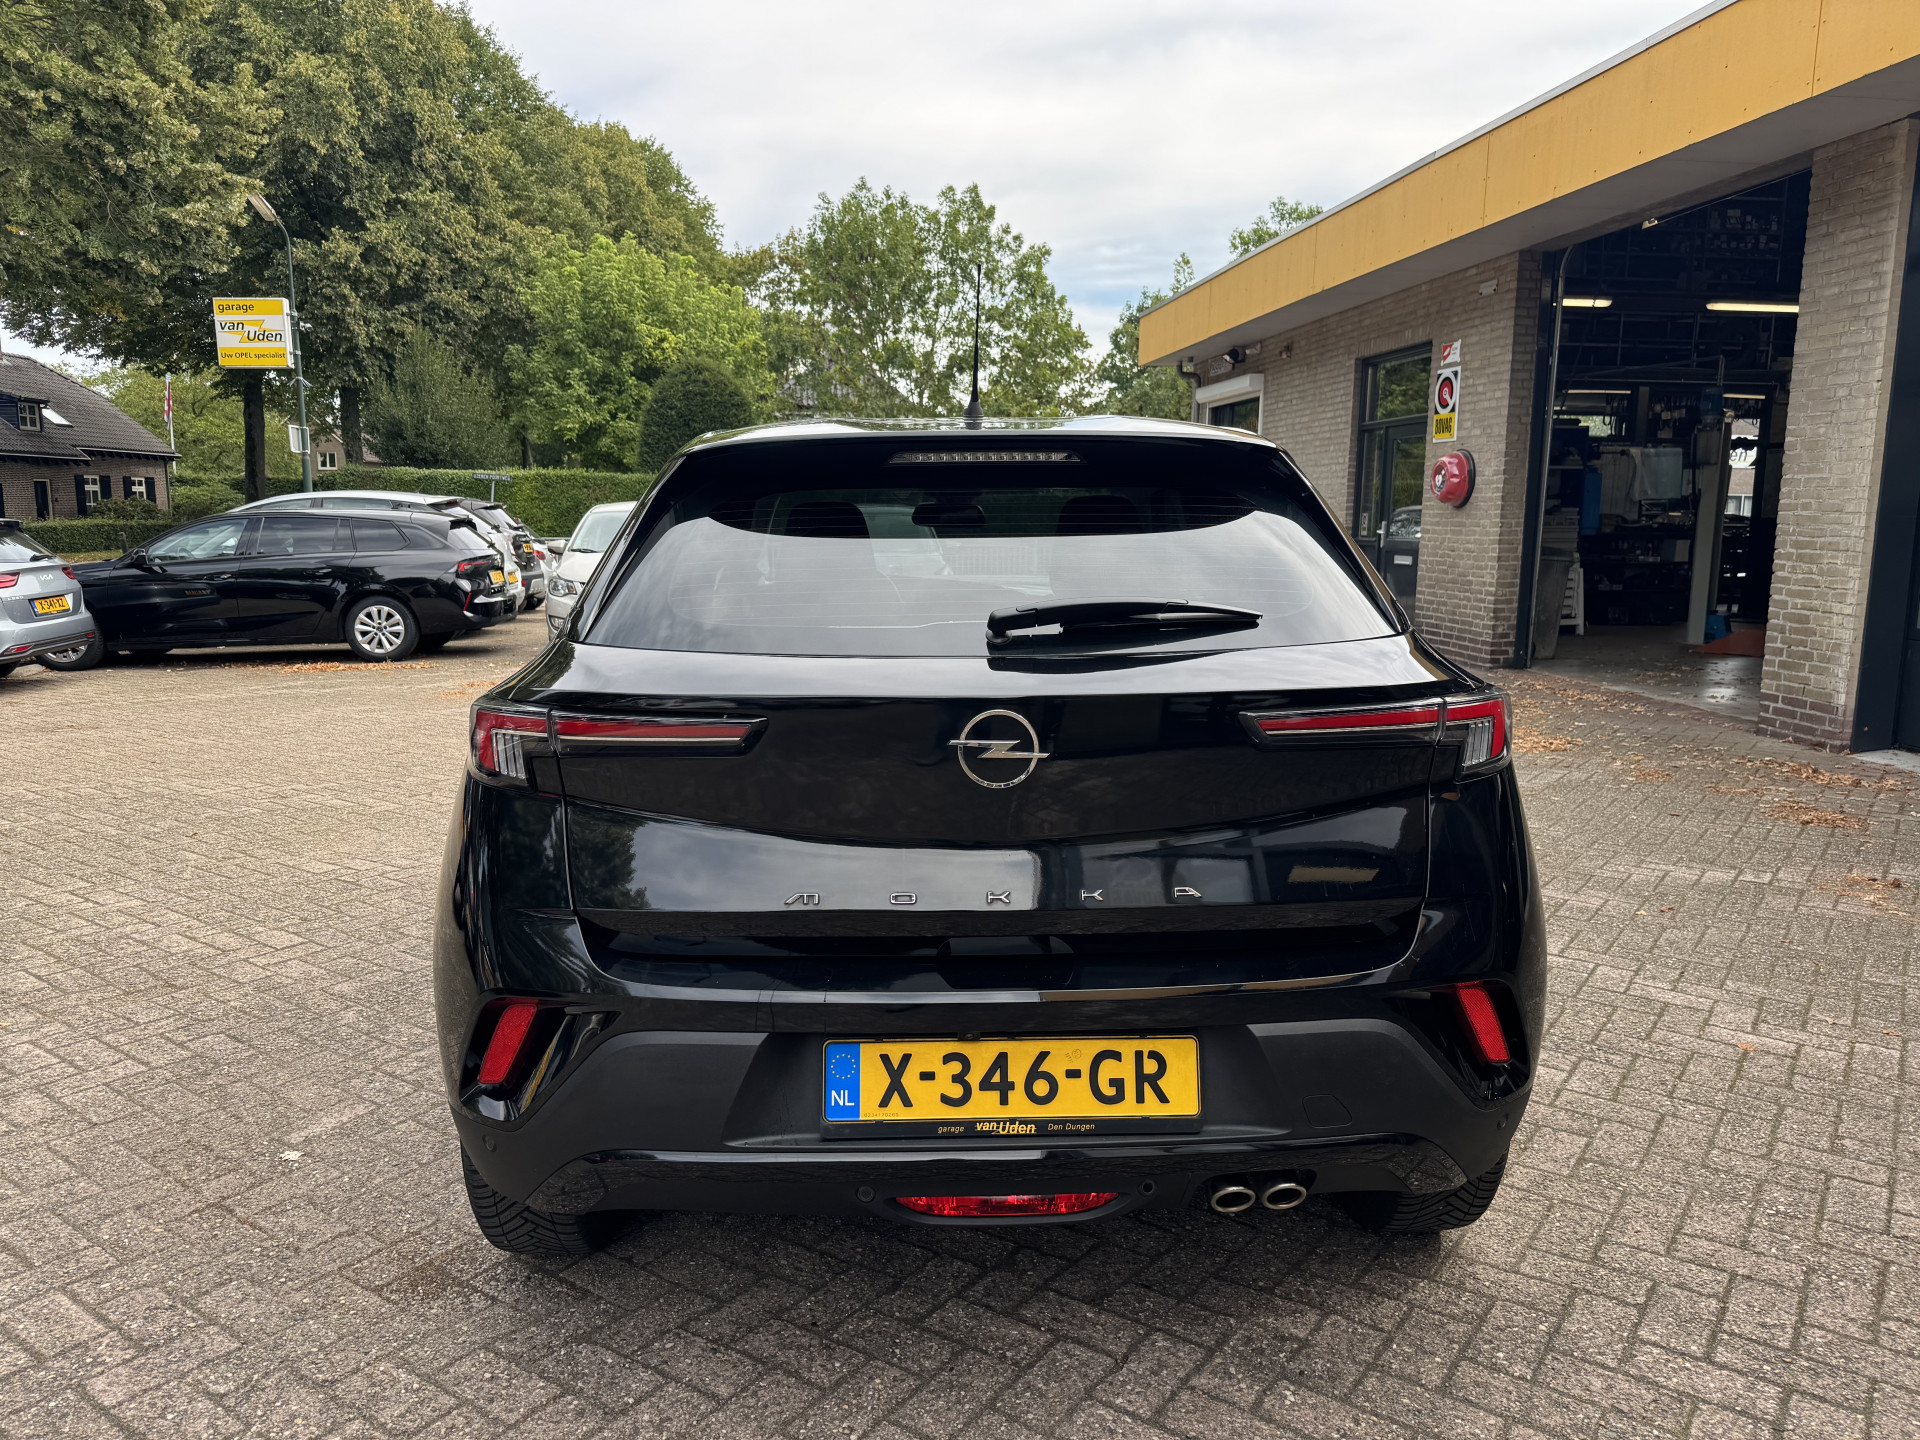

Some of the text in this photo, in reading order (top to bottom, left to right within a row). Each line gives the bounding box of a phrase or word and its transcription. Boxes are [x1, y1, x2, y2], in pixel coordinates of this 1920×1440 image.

[218, 304, 254, 313] garage
[220, 322, 244, 330] van
[246, 330, 282, 342] Uden
[1435, 417, 1452, 434] BOVAG
[784, 886, 1203, 905] MOKKA
[877, 1049, 1171, 1108] X-346-GR
[831, 1089, 855, 1107] NL
[937, 1121, 1096, 1134] garage van Uden Den Dungen
